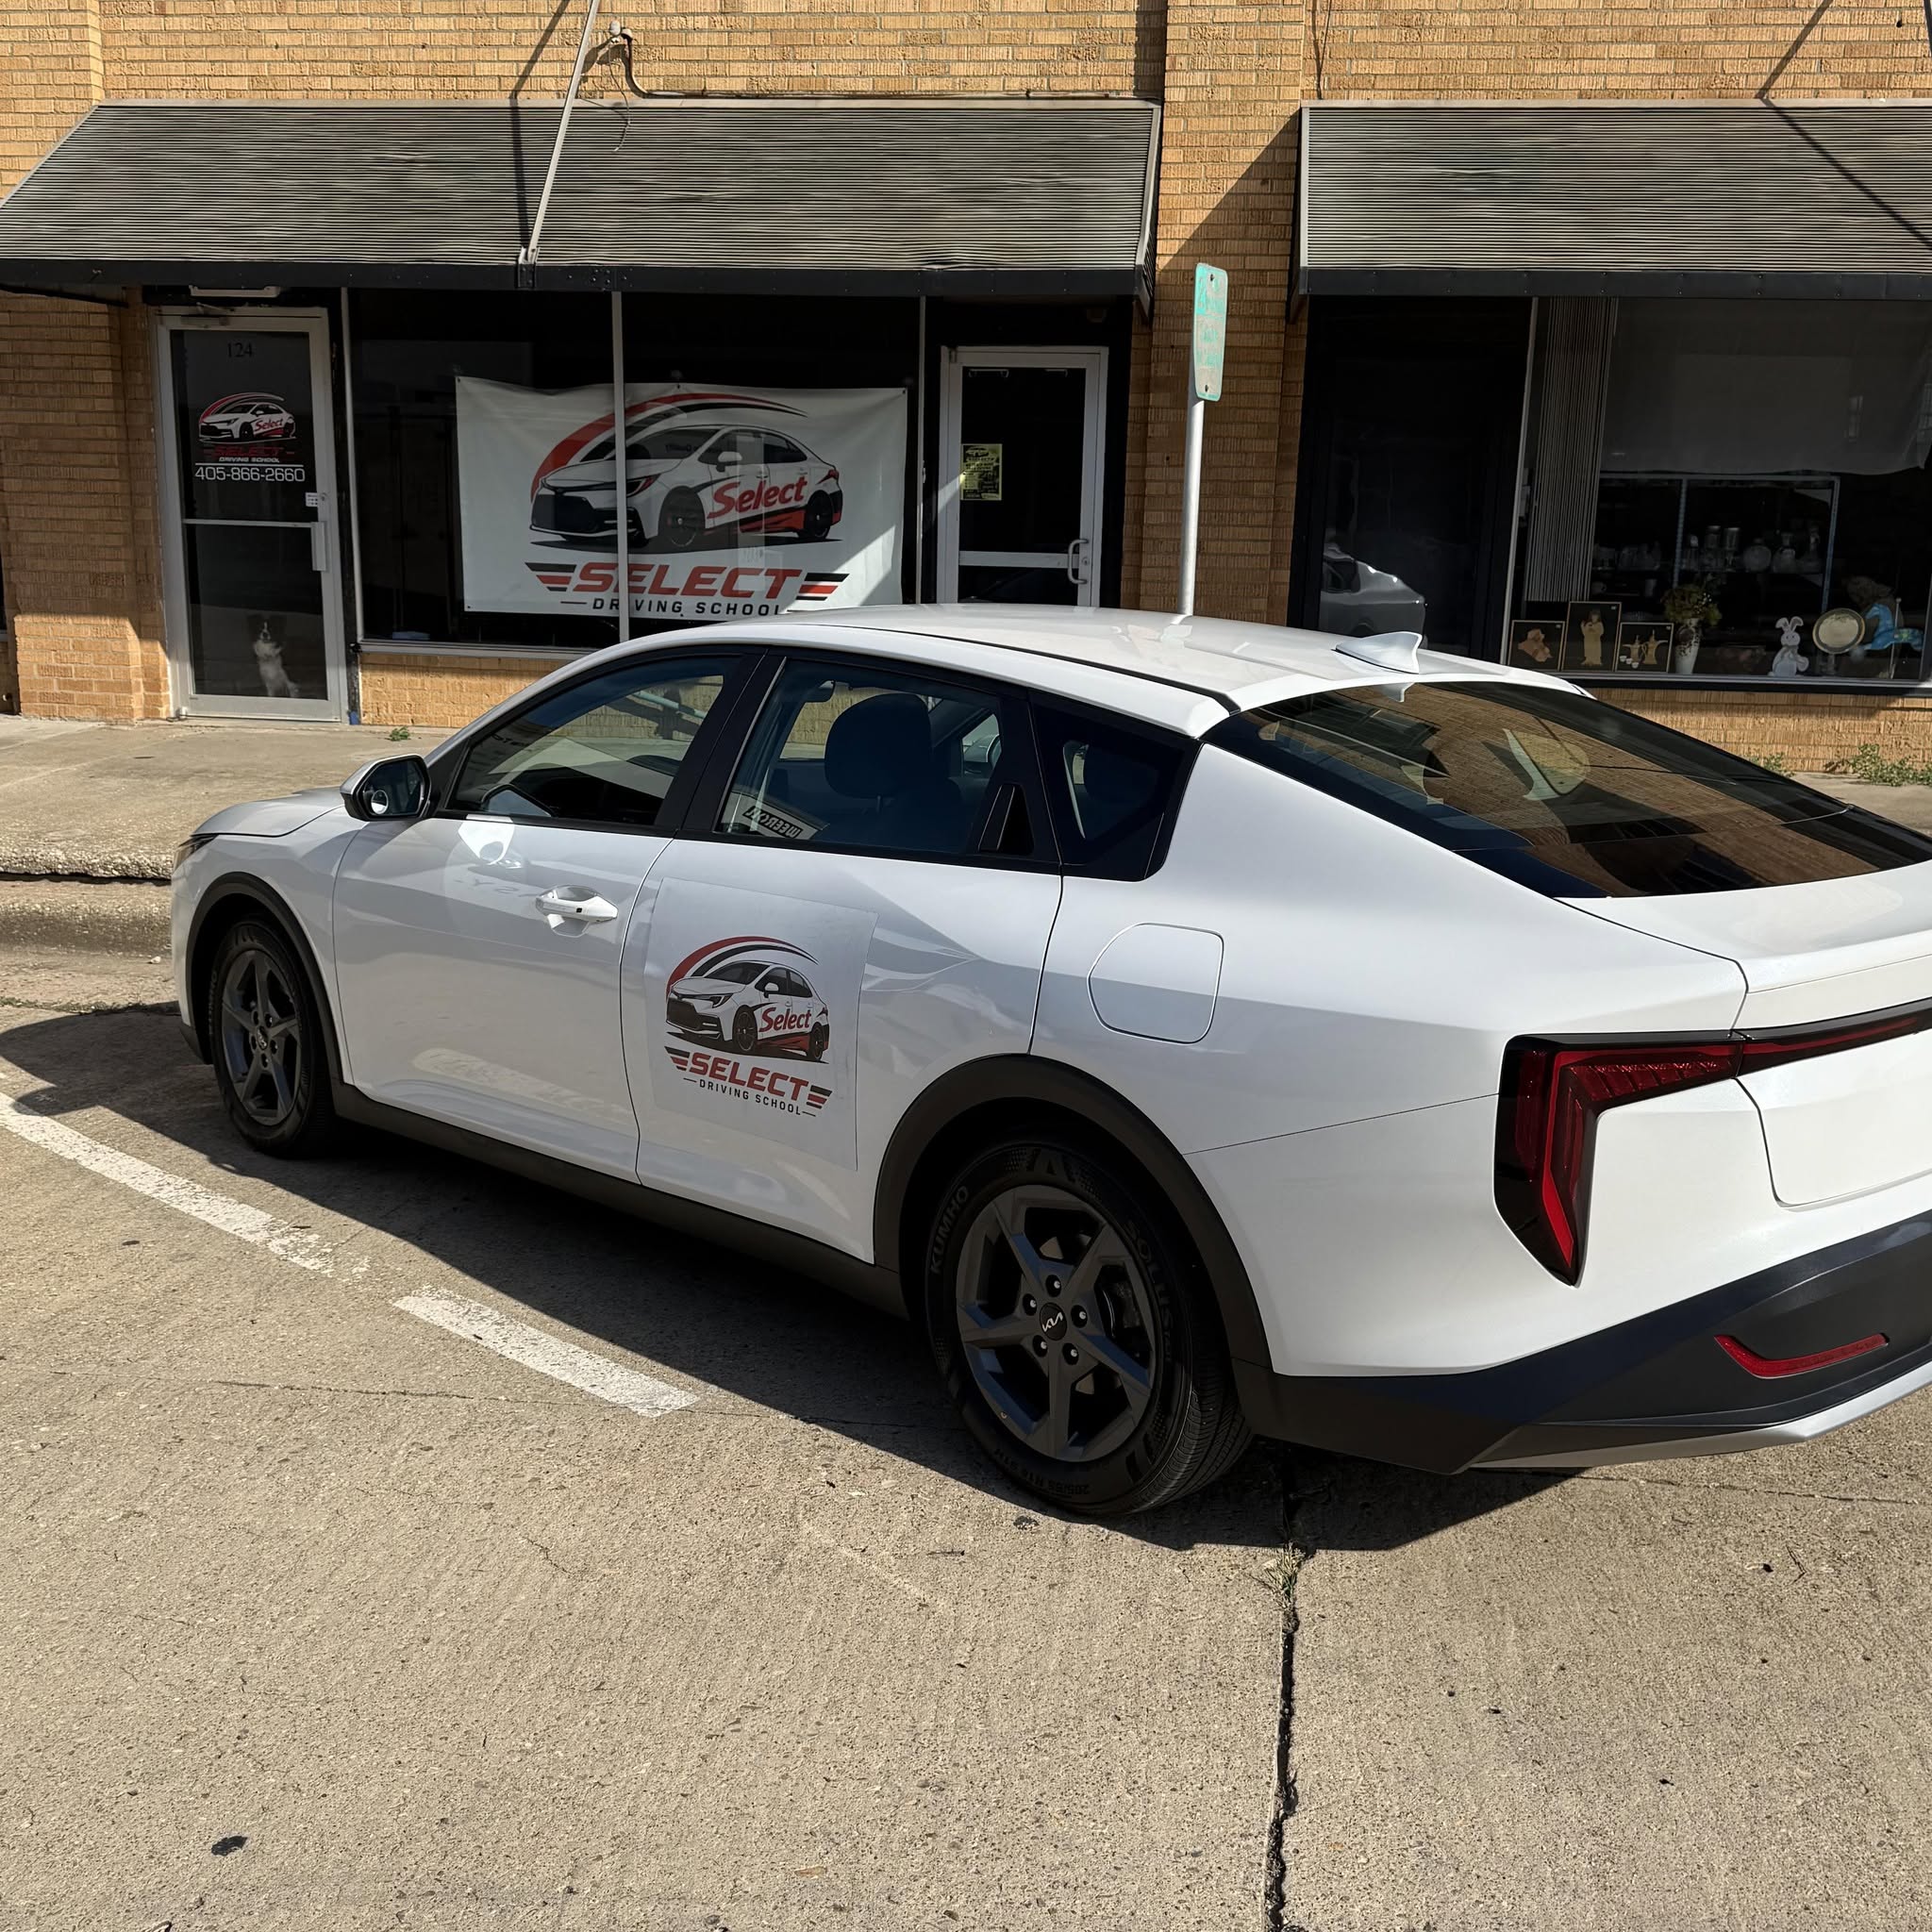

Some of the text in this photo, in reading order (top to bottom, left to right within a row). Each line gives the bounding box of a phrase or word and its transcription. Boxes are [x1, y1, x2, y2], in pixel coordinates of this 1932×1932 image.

[227, 342, 253, 358] 124
[255, 418, 283, 432] Select
[194, 466, 306, 482] 405-866-2660
[707, 475, 808, 520] Select
[573, 561, 802, 599] SELECT
[592, 597, 683, 613] DRVING
[759, 1006, 811, 1033] Select
[689, 1052, 809, 1101] SELECT
[699, 1078, 801, 1115] DRIVING SCHOOL
[929, 1185, 970, 1275] KUMHO
